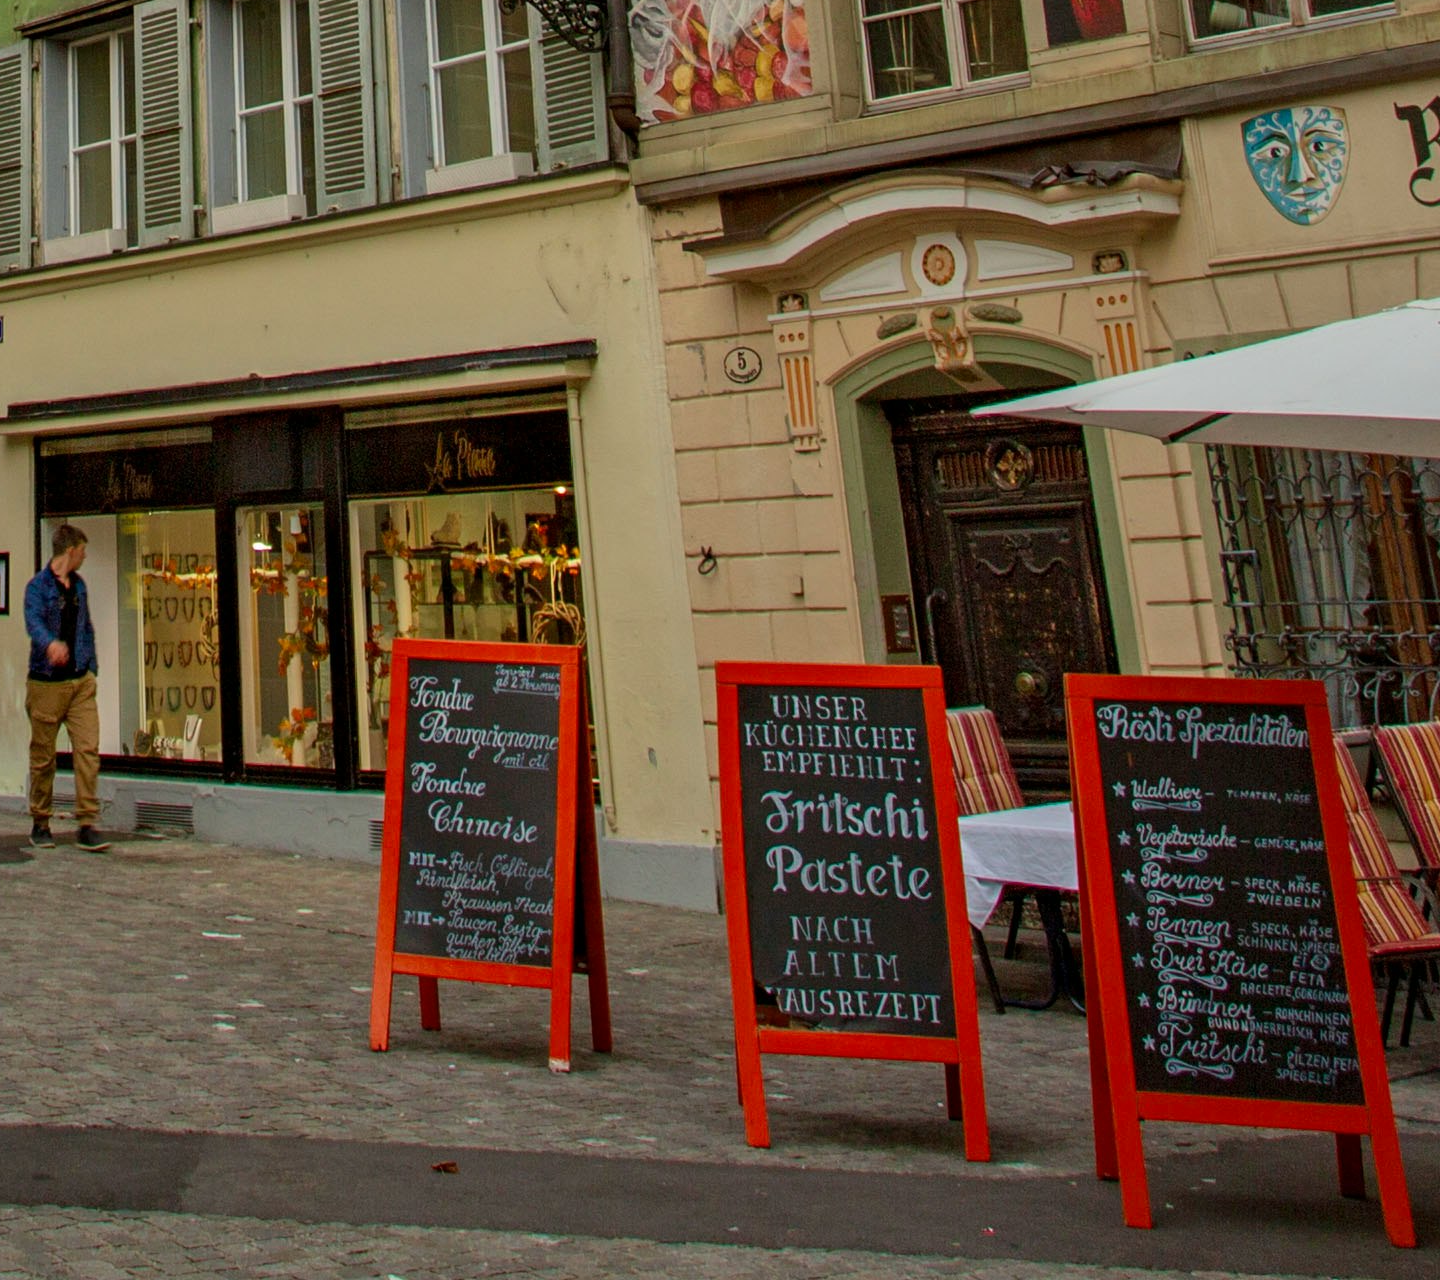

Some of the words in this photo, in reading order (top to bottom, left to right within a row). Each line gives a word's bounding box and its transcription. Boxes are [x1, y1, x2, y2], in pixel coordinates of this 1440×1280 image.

[737, 351, 746, 370] 5
[410, 676, 475, 711] Fondue
[770, 695, 868, 721] UNSER
[419, 710, 559, 763] Bourguignonne
[744, 720, 916, 750] KÜCHENCHEF
[1097, 704, 1175, 741] Rösti
[1176, 706, 1310, 759] Spezialitäten
[411, 761, 486, 797] Fondue
[761, 751, 921, 783] EMPFIEHLT:
[428, 799, 538, 843] Chinoise
[760, 790, 929, 840] Fritschi
[1136, 823, 1238, 857] Vegetarische
[409, 851, 435, 867] MIT
[766, 845, 931, 900] Pastete
[1140, 861, 1225, 891] Berner
[1247, 893, 1321, 908] ZWIEBELN
[404, 910, 431, 926] MIT
[789, 915, 874, 944] NACH
[782, 949, 900, 982] ALTEM
[1151, 942, 1205, 972] Drei
[1209, 950, 1269, 979] Käse
[1289, 971, 1325, 988] FETA
[1156, 985, 1256, 1019] Bündner
